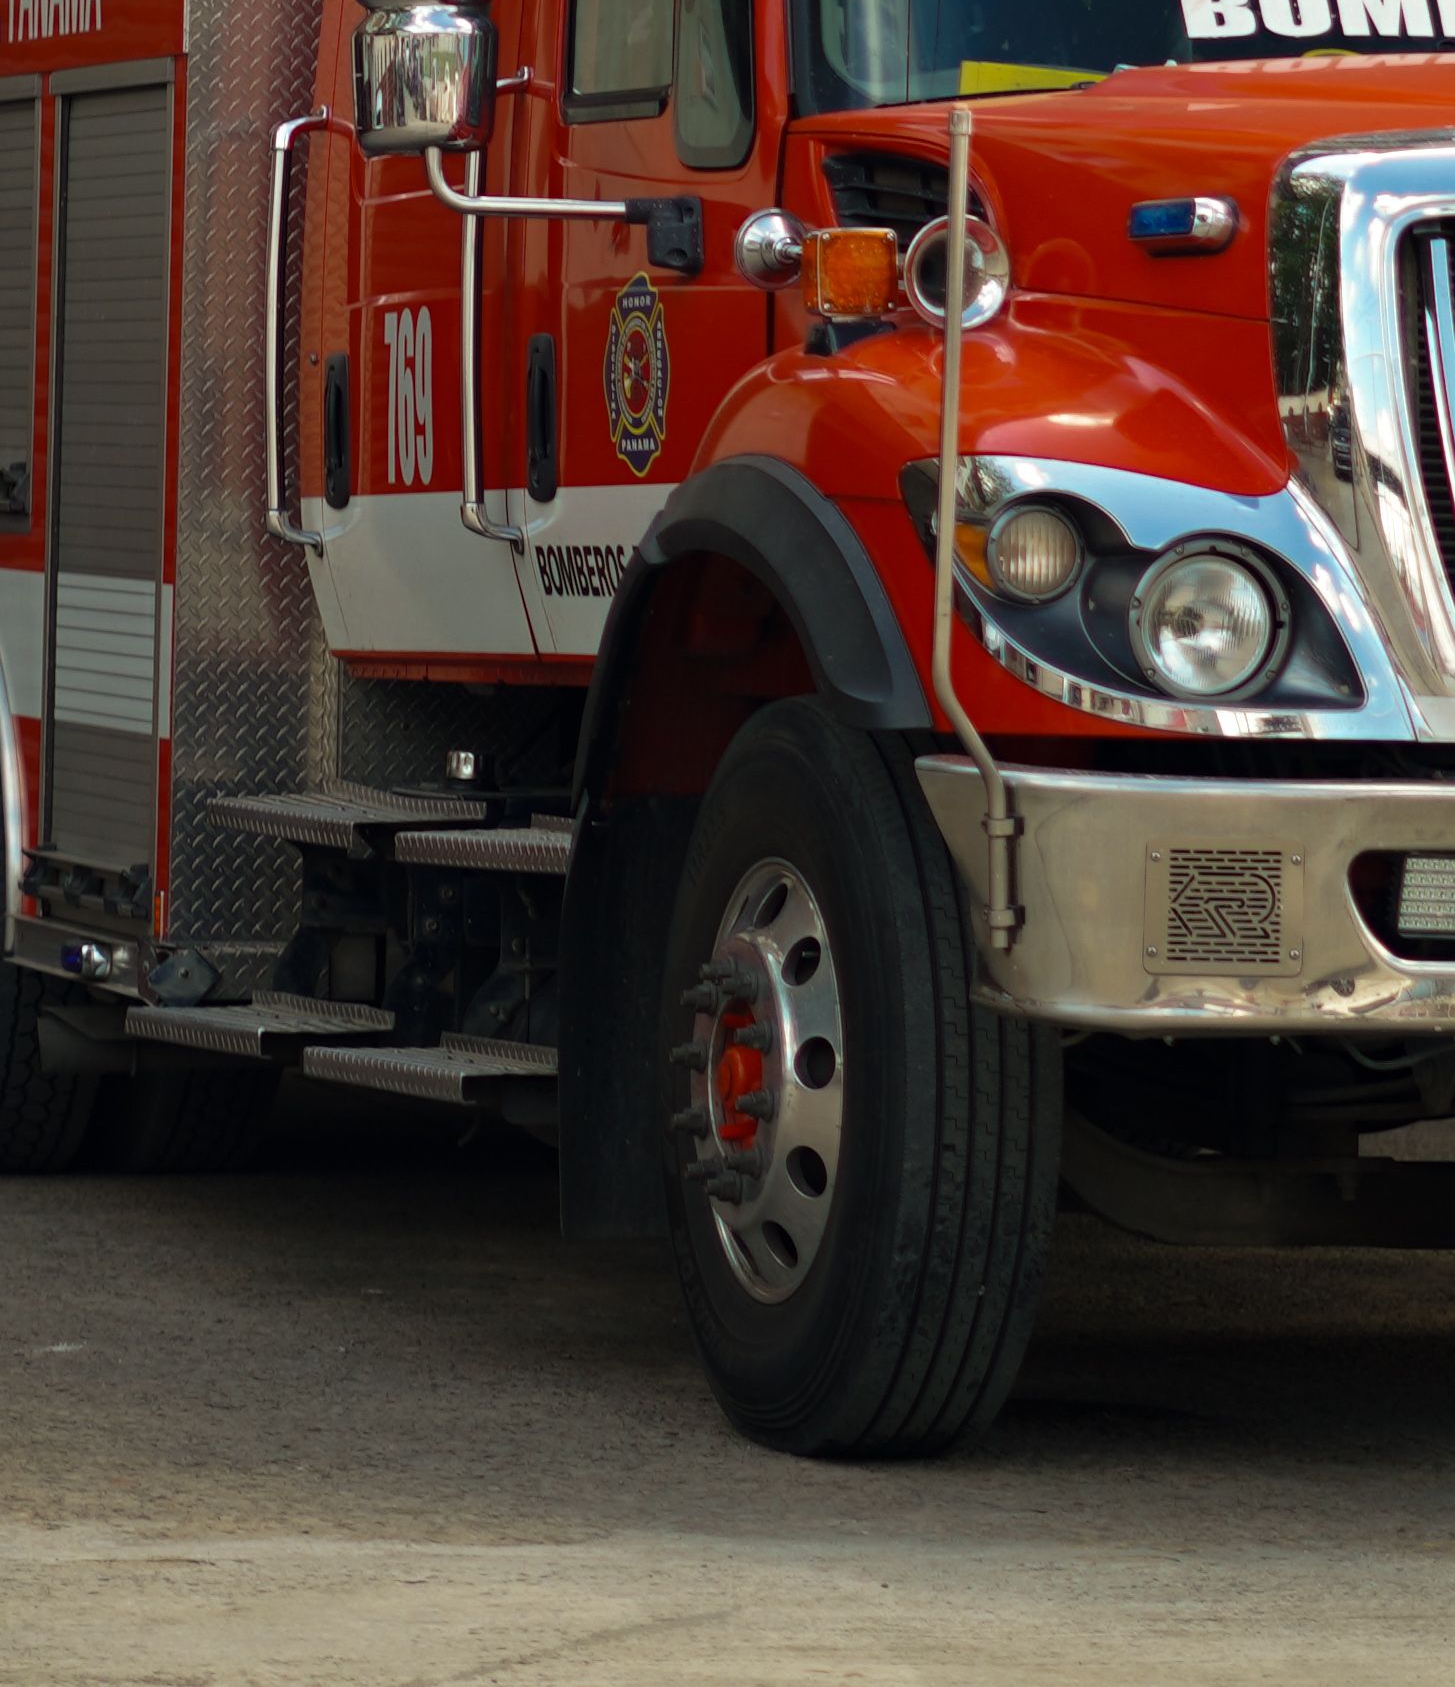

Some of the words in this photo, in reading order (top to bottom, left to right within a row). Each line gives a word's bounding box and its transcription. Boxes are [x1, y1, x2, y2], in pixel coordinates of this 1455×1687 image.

[622, 295, 651, 308] HONOR
[384, 305, 433, 486] 769
[621, 438, 656, 452] PANAMA
